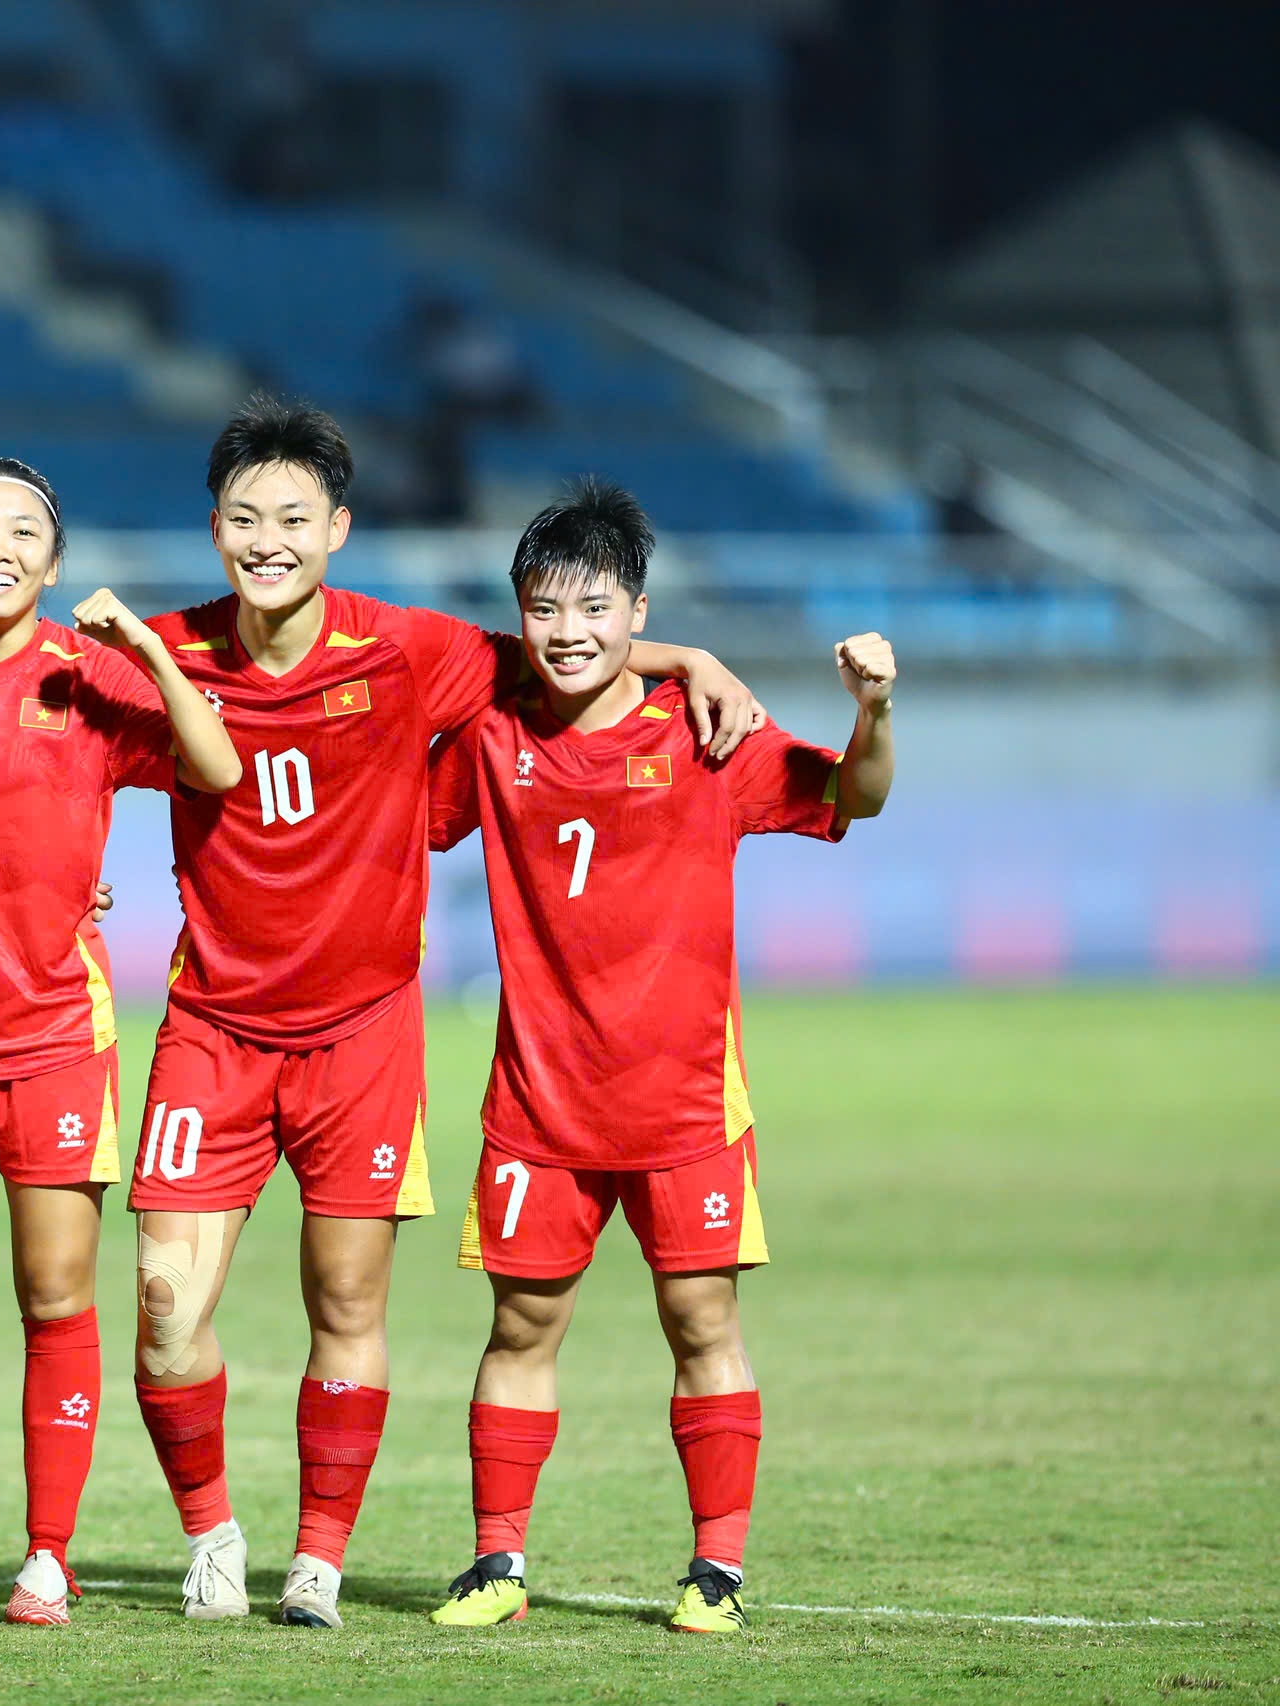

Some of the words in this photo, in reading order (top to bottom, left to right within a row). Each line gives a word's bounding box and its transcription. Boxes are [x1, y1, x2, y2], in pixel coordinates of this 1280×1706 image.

[254, 747, 315, 827] 10
[558, 817, 596, 899] 7
[142, 1101, 204, 1181] 10
[494, 1160, 531, 1239] 7
